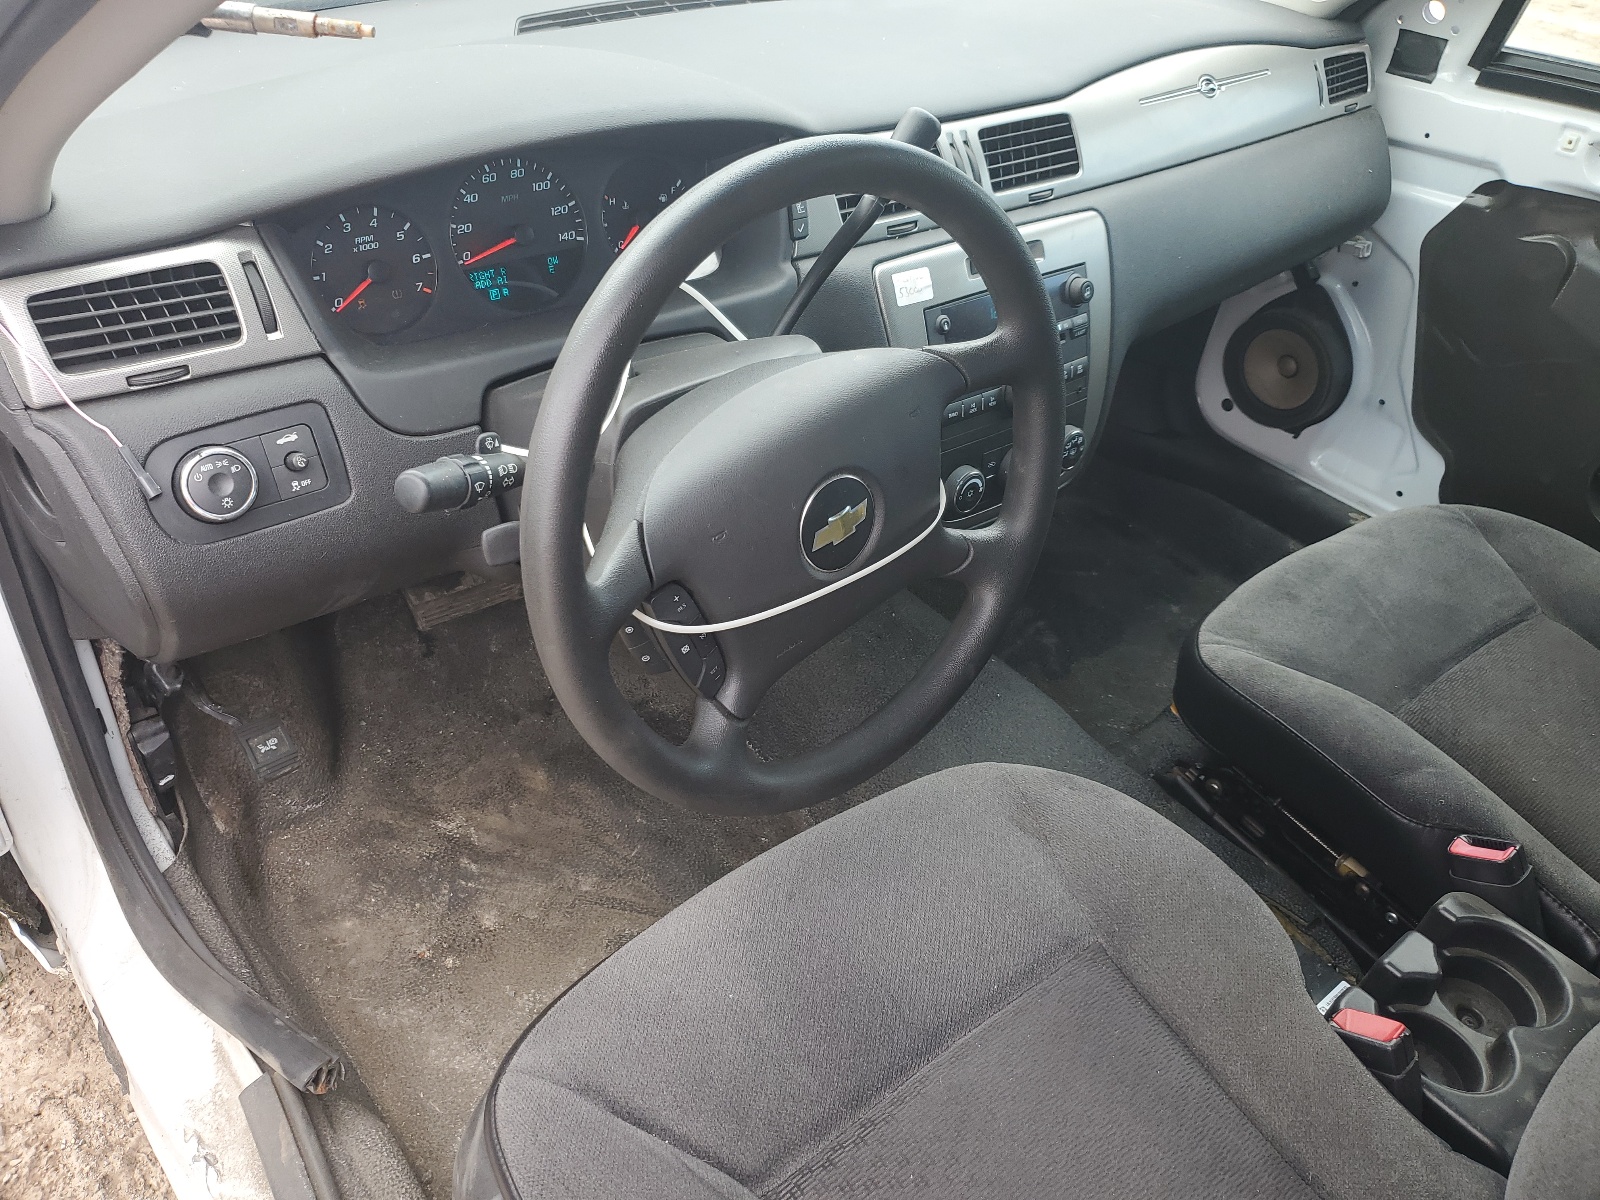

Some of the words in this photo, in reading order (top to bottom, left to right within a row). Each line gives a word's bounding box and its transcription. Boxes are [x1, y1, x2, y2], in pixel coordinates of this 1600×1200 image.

[482, 172, 497, 184] 60
[510, 168, 525, 179] 80
[532, 180, 551, 192] 100
[671, 186, 676, 194] F
[463, 193, 479, 203] 40
[501, 194, 519, 203] MPH
[609, 197, 616, 206] H
[551, 204, 569, 216] 120
[343, 222, 351, 233] 3
[369, 218, 378, 228] 4
[457, 223, 472, 234] 20
[355, 234, 374, 245] RPM
[396, 230, 405, 241] 5
[558, 230, 576, 242] 140
[324, 243, 333, 254] 2
[412, 253, 421, 264] 6
[463, 251, 471, 261] 0
[321, 272, 326, 282] 1
[415, 282, 423, 292] 7
[335, 297, 344, 308] 0
[200, 463, 214, 472] AUTO
[301, 479, 312, 487] OFF
